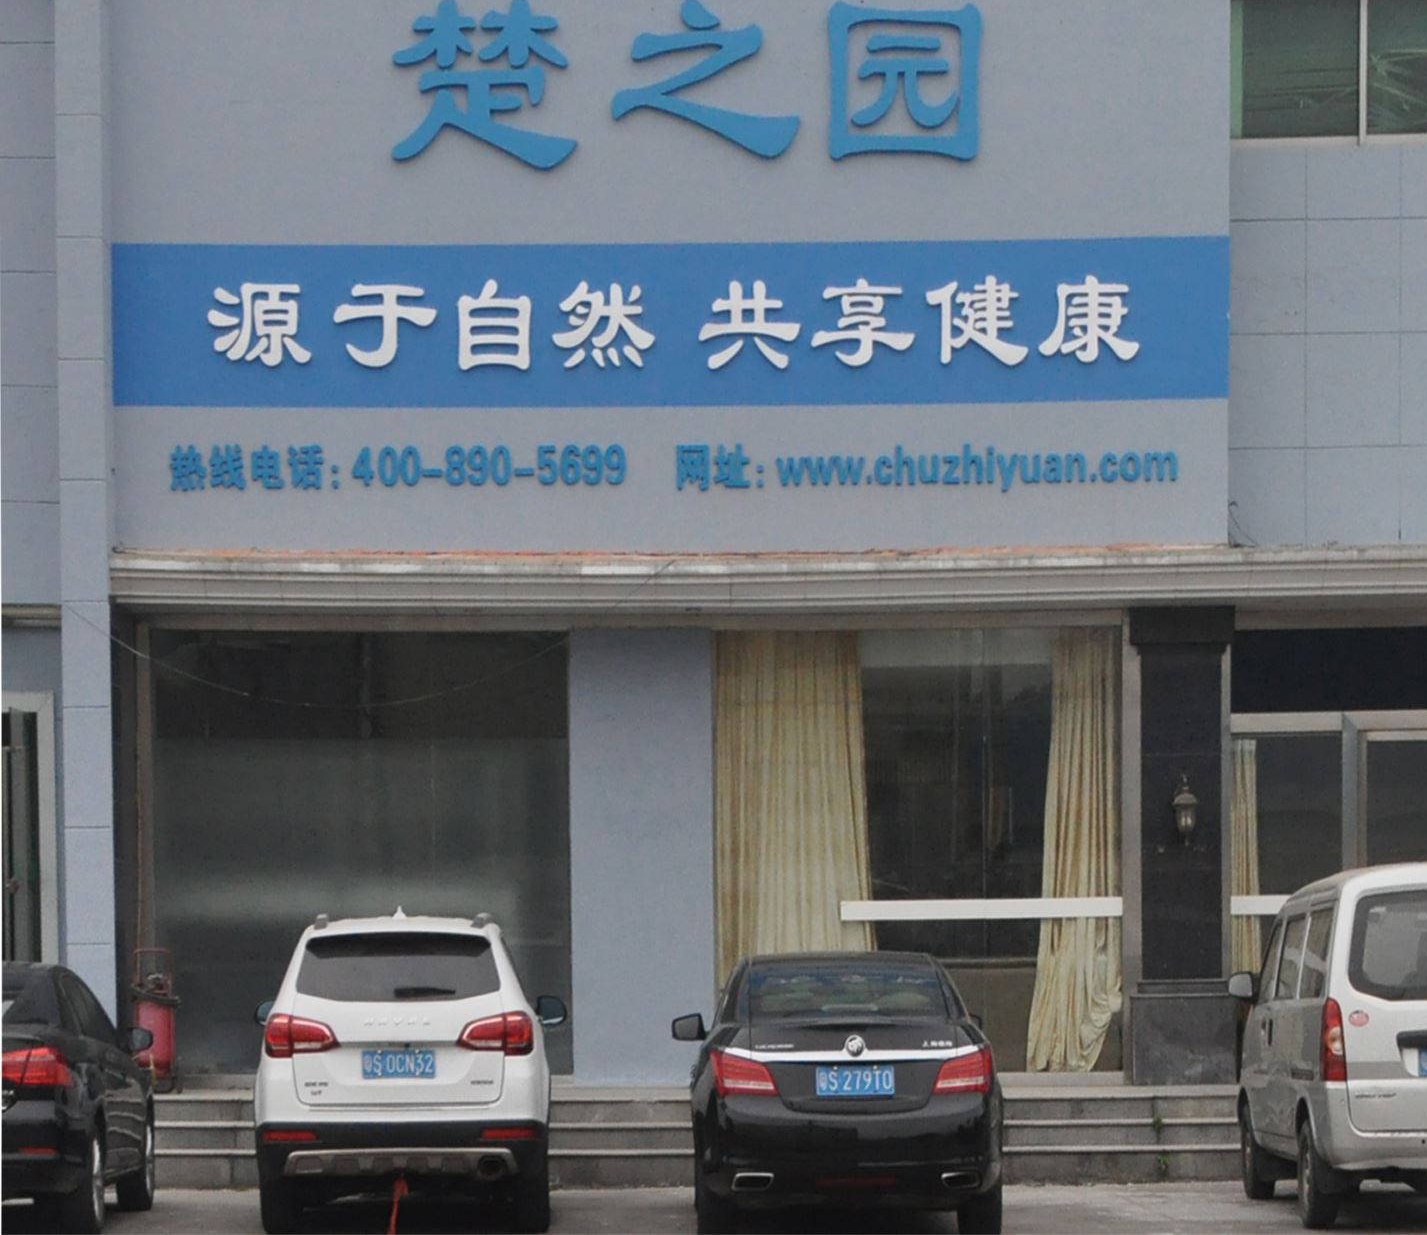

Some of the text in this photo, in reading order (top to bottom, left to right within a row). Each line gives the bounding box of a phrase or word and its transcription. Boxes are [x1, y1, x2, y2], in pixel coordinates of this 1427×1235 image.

[206, 276, 1140, 370] 源于自然 共享健康
